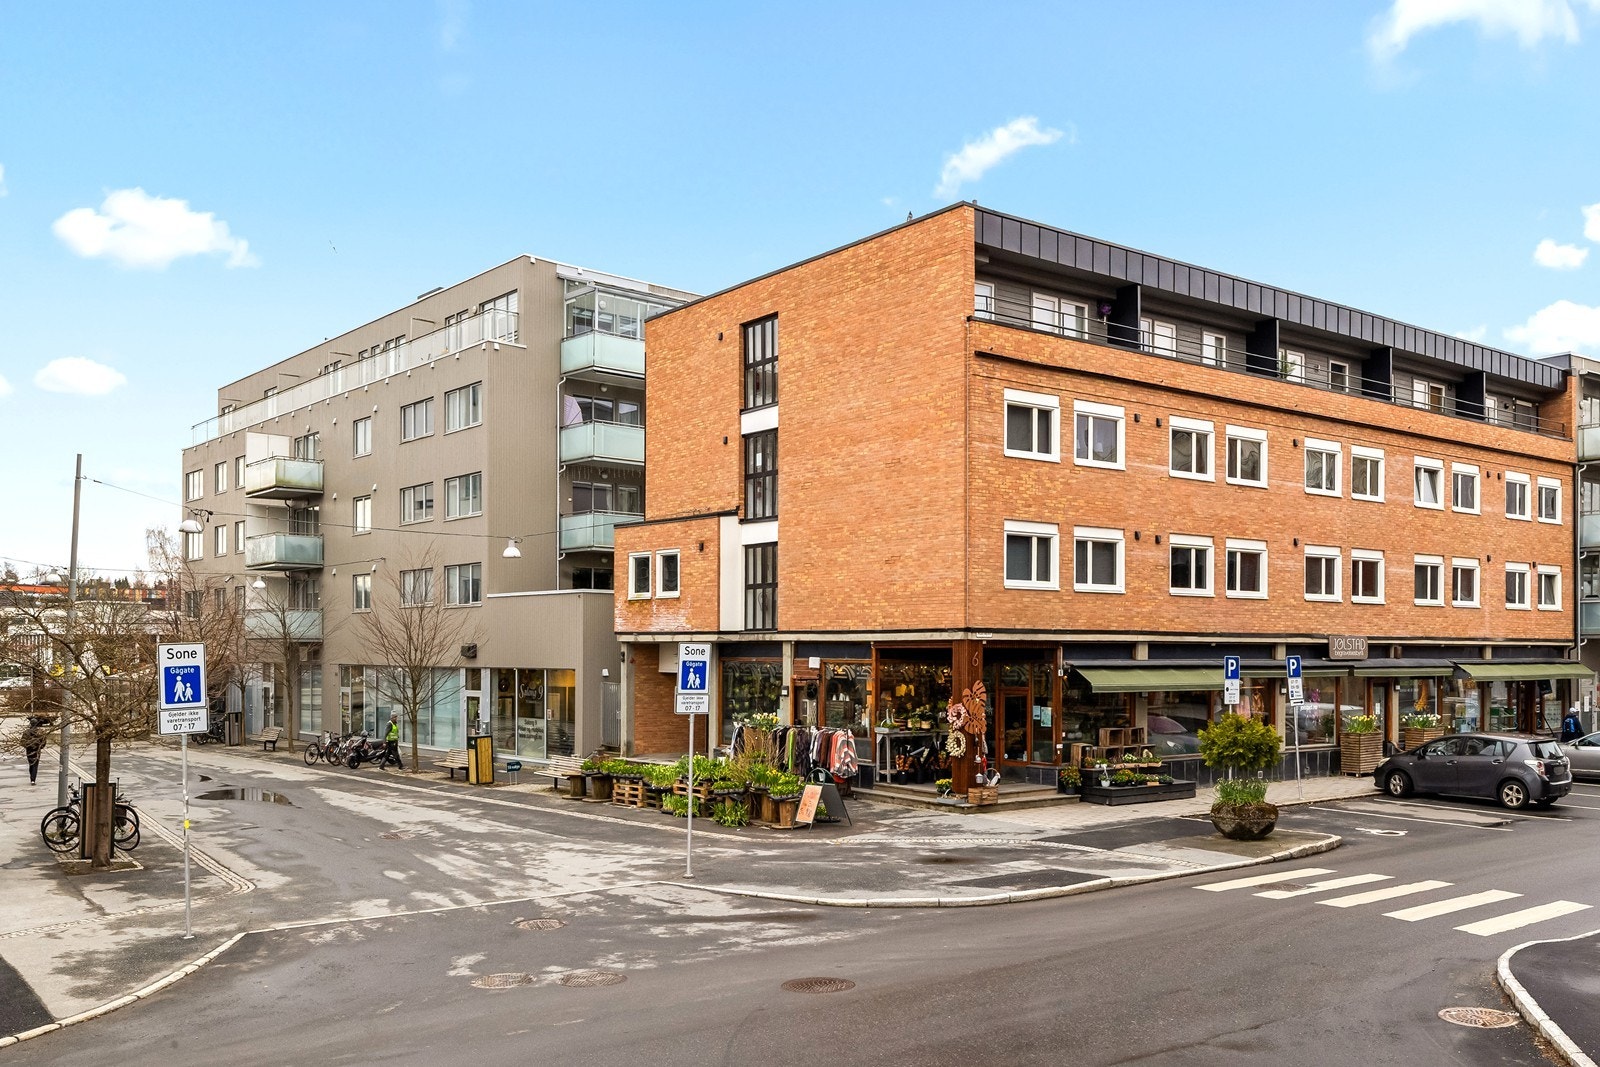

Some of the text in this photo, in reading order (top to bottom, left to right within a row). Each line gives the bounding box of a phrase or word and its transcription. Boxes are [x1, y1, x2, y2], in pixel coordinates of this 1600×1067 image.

[684, 646, 706, 656] Sone
[1333, 638, 1366, 651] JØLSTAD
[166, 647, 198, 660] Sone
[971, 651, 979, 667] 6
[1228, 659, 1237, 677] P
[1289, 659, 1298, 676] P
[538, 686, 544, 700] 9
[166, 716, 201, 724] varetransport
